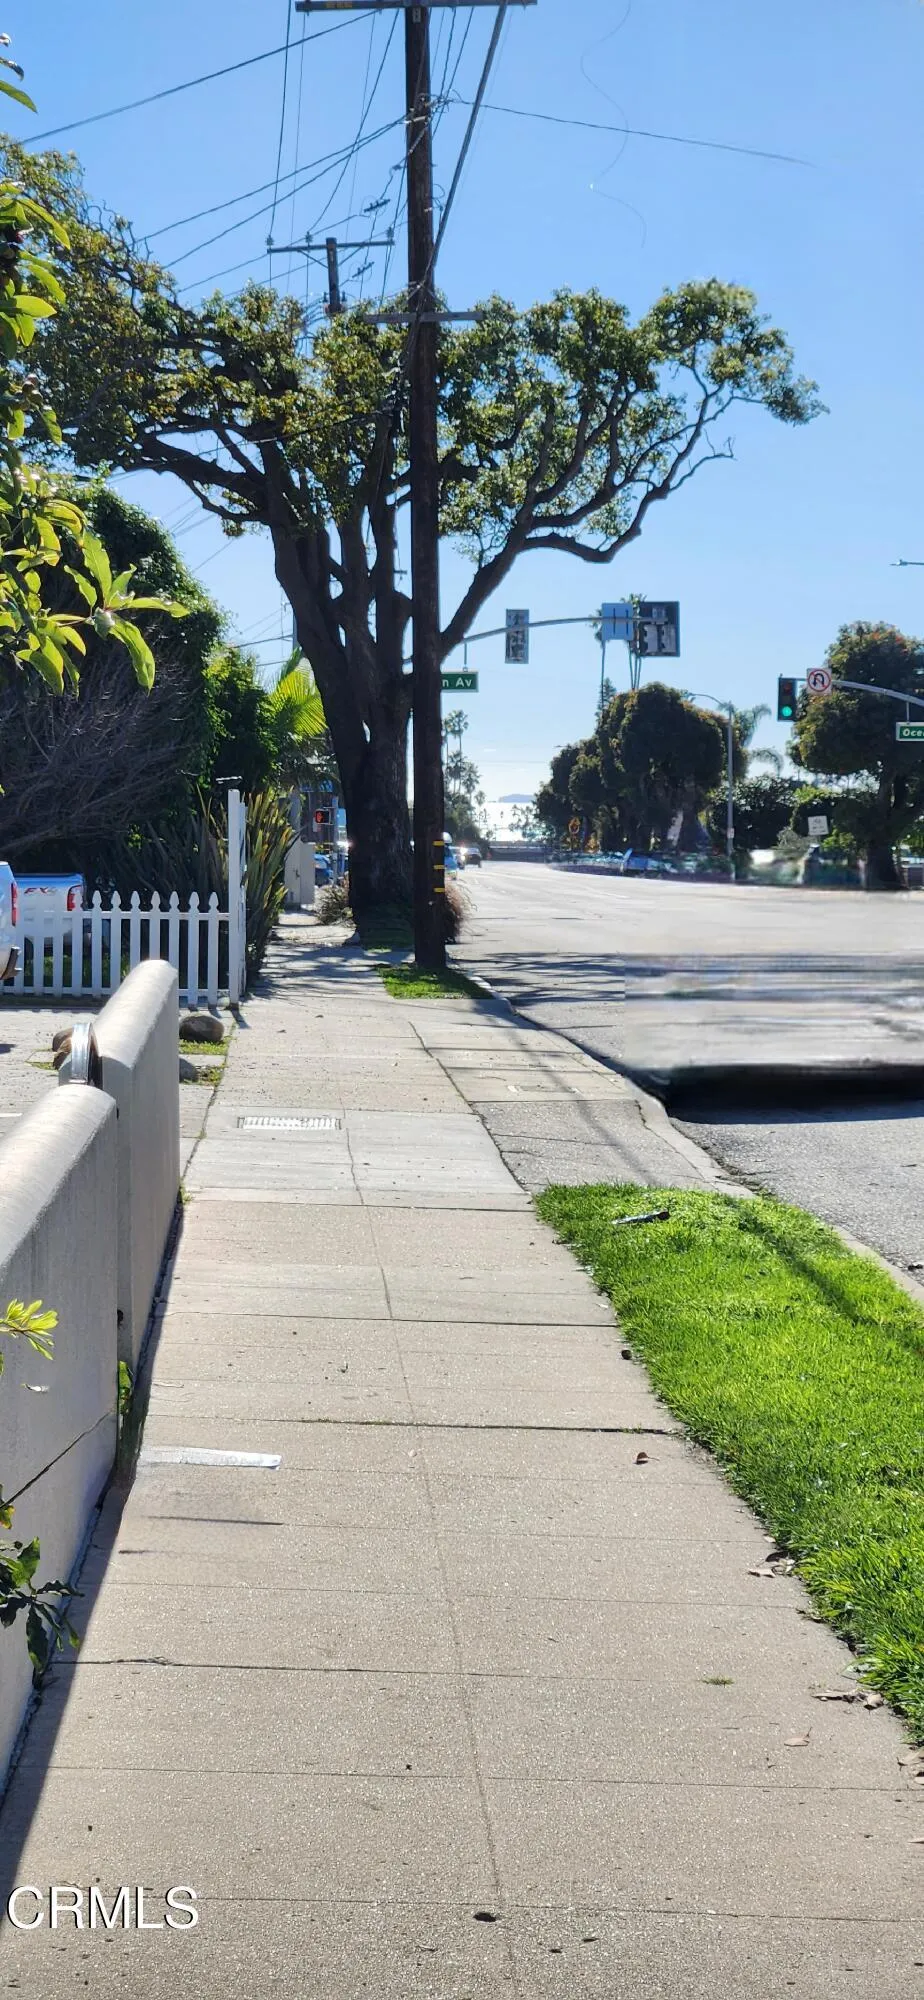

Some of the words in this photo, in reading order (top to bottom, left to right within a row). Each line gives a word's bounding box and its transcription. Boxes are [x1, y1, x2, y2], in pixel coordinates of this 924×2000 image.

[442, 679, 449, 687] n
[455, 677, 472, 687] Av
[902, 728, 924, 737] Oce
